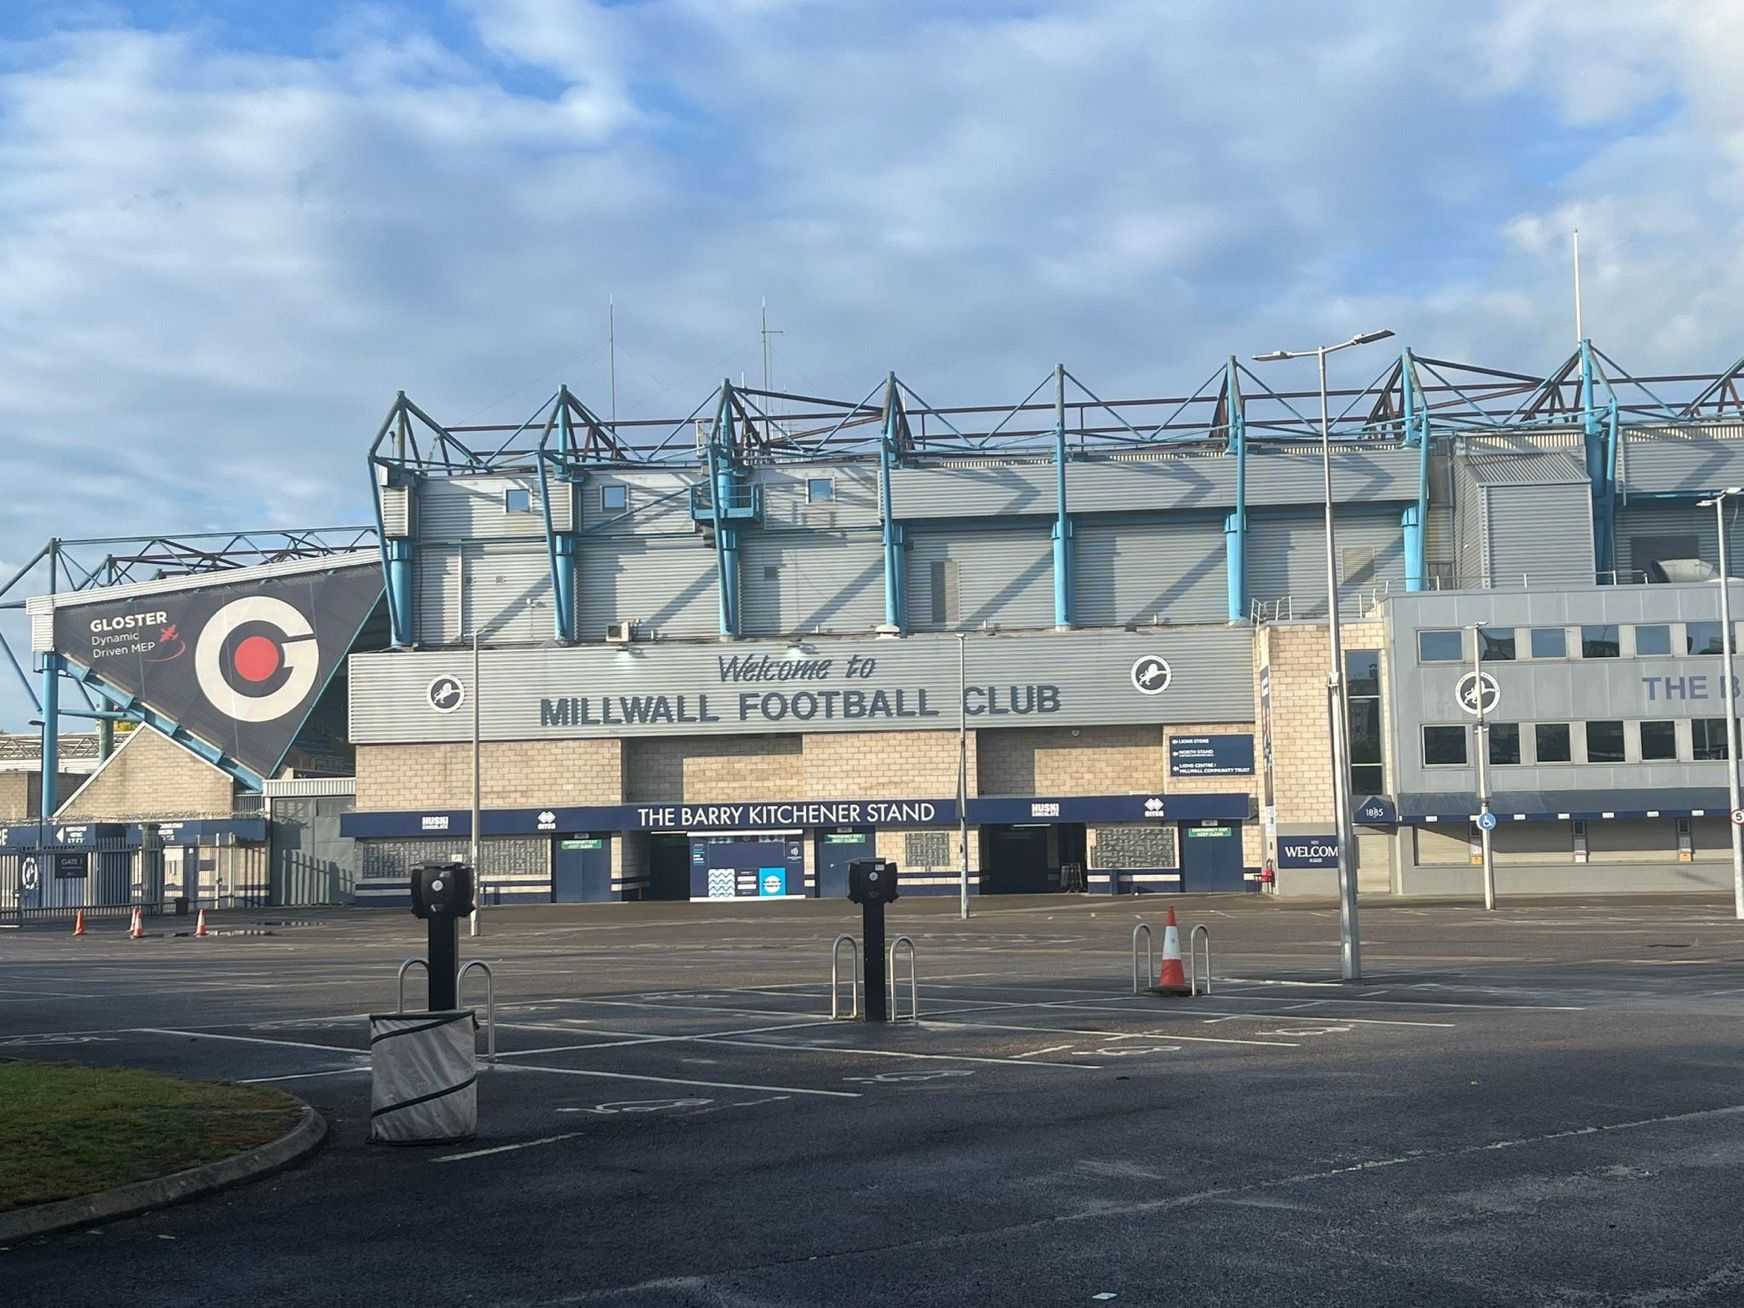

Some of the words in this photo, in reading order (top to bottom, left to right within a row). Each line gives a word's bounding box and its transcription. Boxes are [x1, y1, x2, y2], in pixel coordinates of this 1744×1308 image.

[90, 611, 168, 632] GLOSTER
[92, 632, 139, 646] Dynamic
[93, 647, 128, 658] Driven
[131, 641, 156, 653] MEP
[719, 654, 831, 682] Welcome
[845, 654, 877, 679] to
[1642, 676, 1708, 700] THE
[541, 694, 720, 726] MILLWALL
[739, 688, 940, 721] FOOTBALL
[963, 684, 1061, 716] CLUB
[638, 808, 675, 827] THE
[681, 806, 743, 826] BARRY
[749, 804, 861, 824] KITCHENER
[866, 803, 935, 822] STAND
[1032, 803, 1059, 812] HUSKI
[1366, 808, 1384, 817] 1885
[422, 816, 449, 825] HUSKI
[1736, 812, 1743, 821] 5
[1285, 846, 1339, 857] WELCOM
